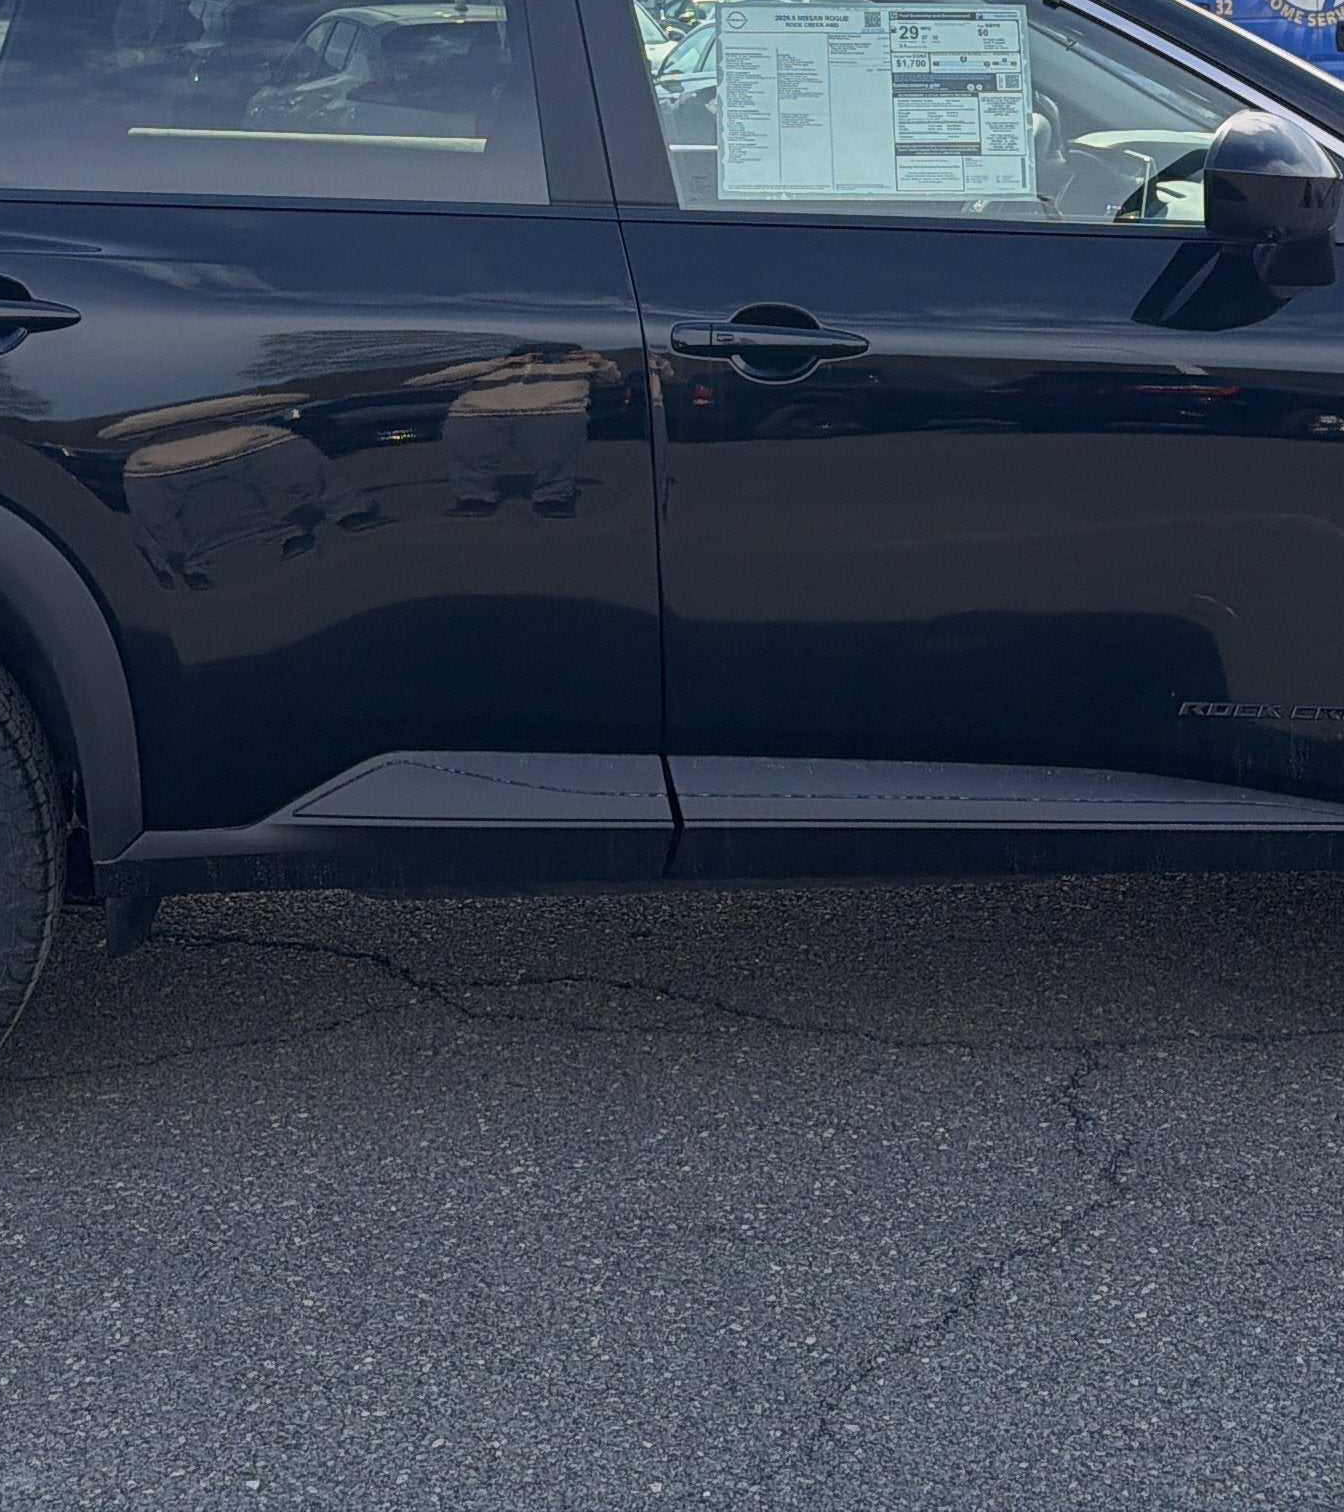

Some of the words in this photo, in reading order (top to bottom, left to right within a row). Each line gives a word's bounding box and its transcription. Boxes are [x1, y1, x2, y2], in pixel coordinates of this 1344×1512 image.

[899, 25, 919, 40] 29
[896, 59, 927, 68] $1,700
[1178, 701, 1283, 719] ROCK
